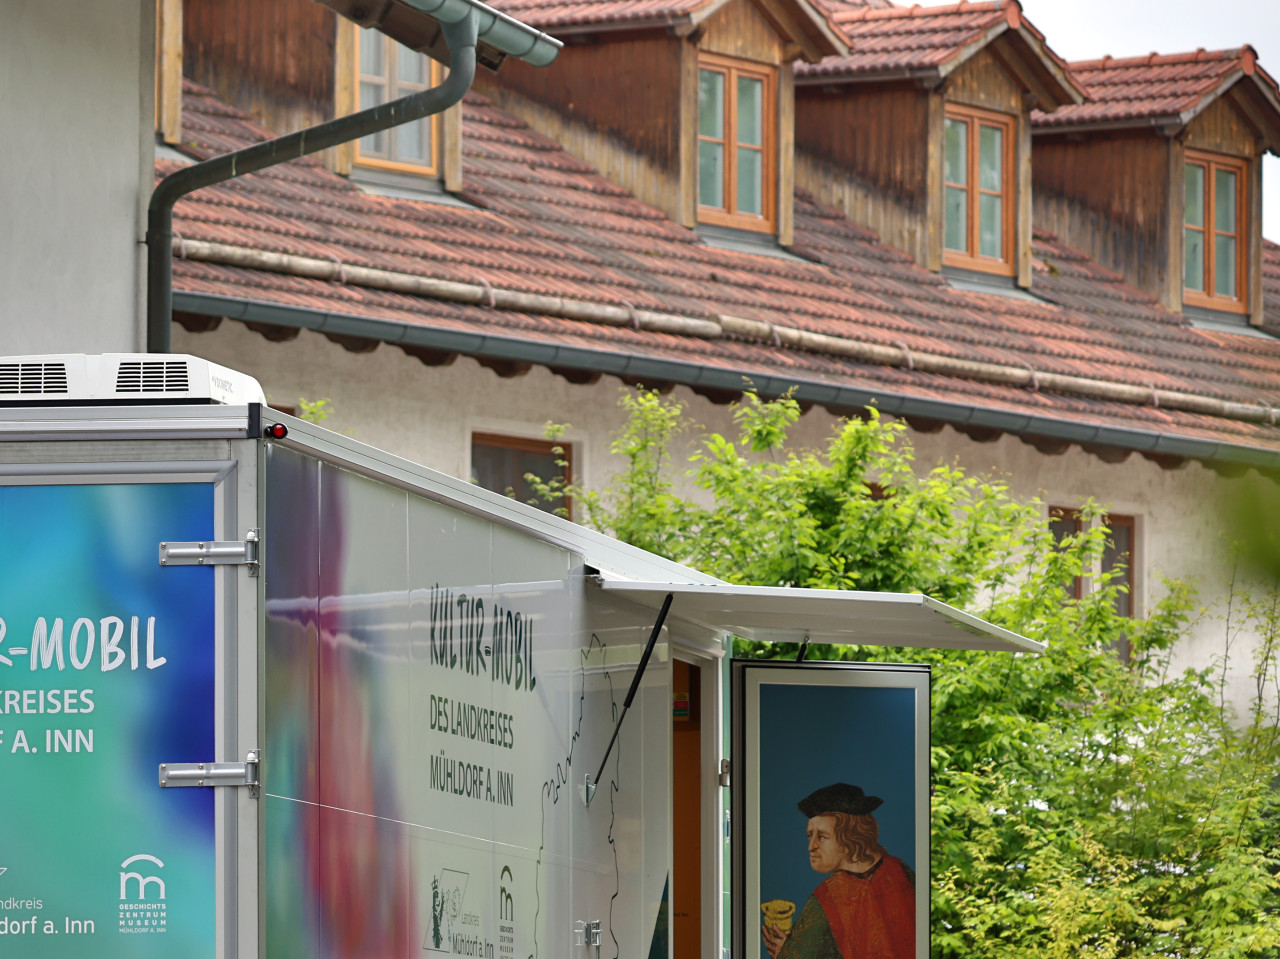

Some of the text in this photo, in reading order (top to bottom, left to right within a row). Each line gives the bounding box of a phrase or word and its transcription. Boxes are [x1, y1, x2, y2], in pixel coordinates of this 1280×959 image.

[430, 582, 536, 692] KULTUR-MOBIL
[11, 730, 37, 754] A.
[46, 729, 94, 753] INN
[430, 694, 514, 749] DES LANDKREISES
[430, 750, 514, 807] MÜHLDORF A. INN
[43, 921, 59, 935] a.
[65, 917, 95, 934] Inn
[452, 933, 478, 957] Mühldorf
[484, 938, 494, 959] Inn
